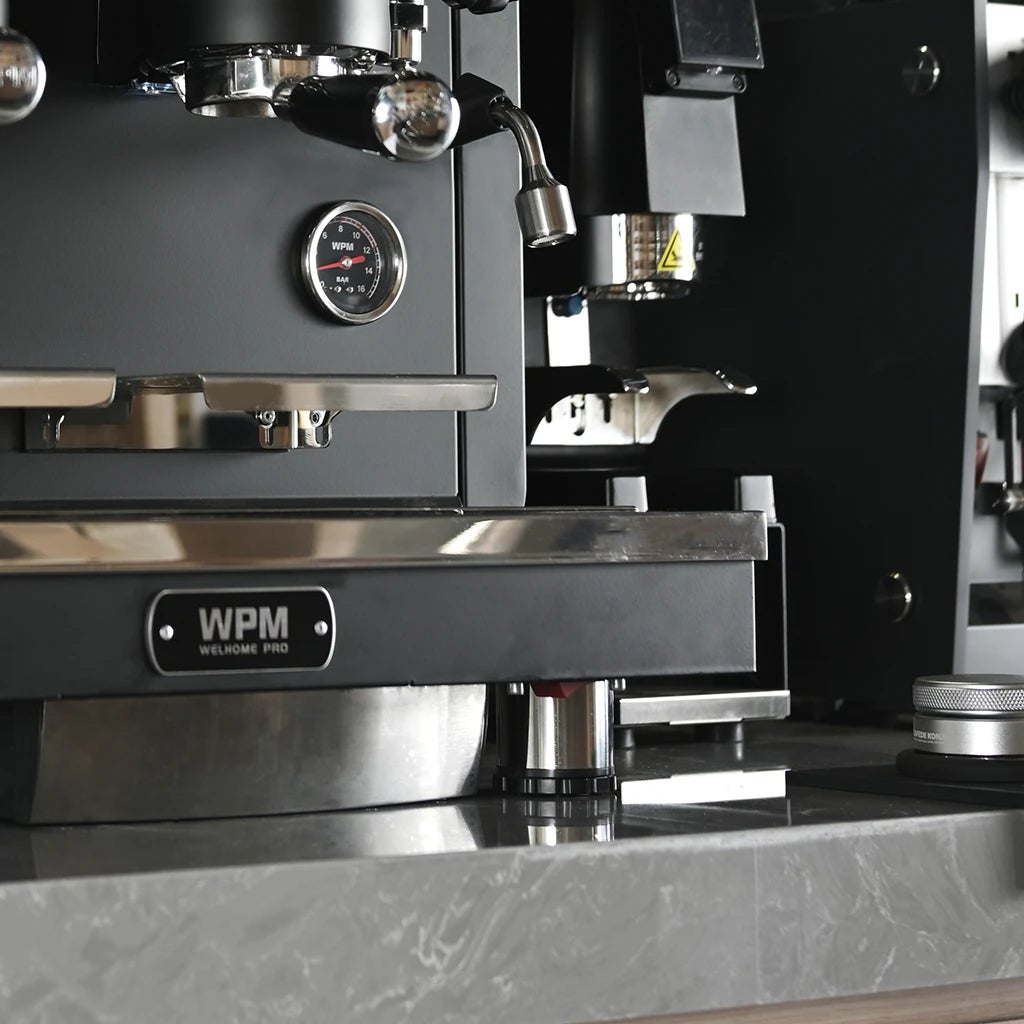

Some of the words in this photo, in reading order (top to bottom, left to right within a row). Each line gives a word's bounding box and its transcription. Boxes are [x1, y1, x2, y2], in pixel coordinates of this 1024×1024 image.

[337, 225, 344, 233] 8
[322, 231, 328, 239] 6
[352, 232, 361, 240] 10
[331, 241, 355, 252] WPM
[363, 246, 371, 255] 12
[365, 267, 373, 275] 14
[357, 285, 366, 293] 16
[198, 606, 289, 642] WPM
[199, 643, 258, 656] WELHOME
[262, 642, 289, 654] PRO
